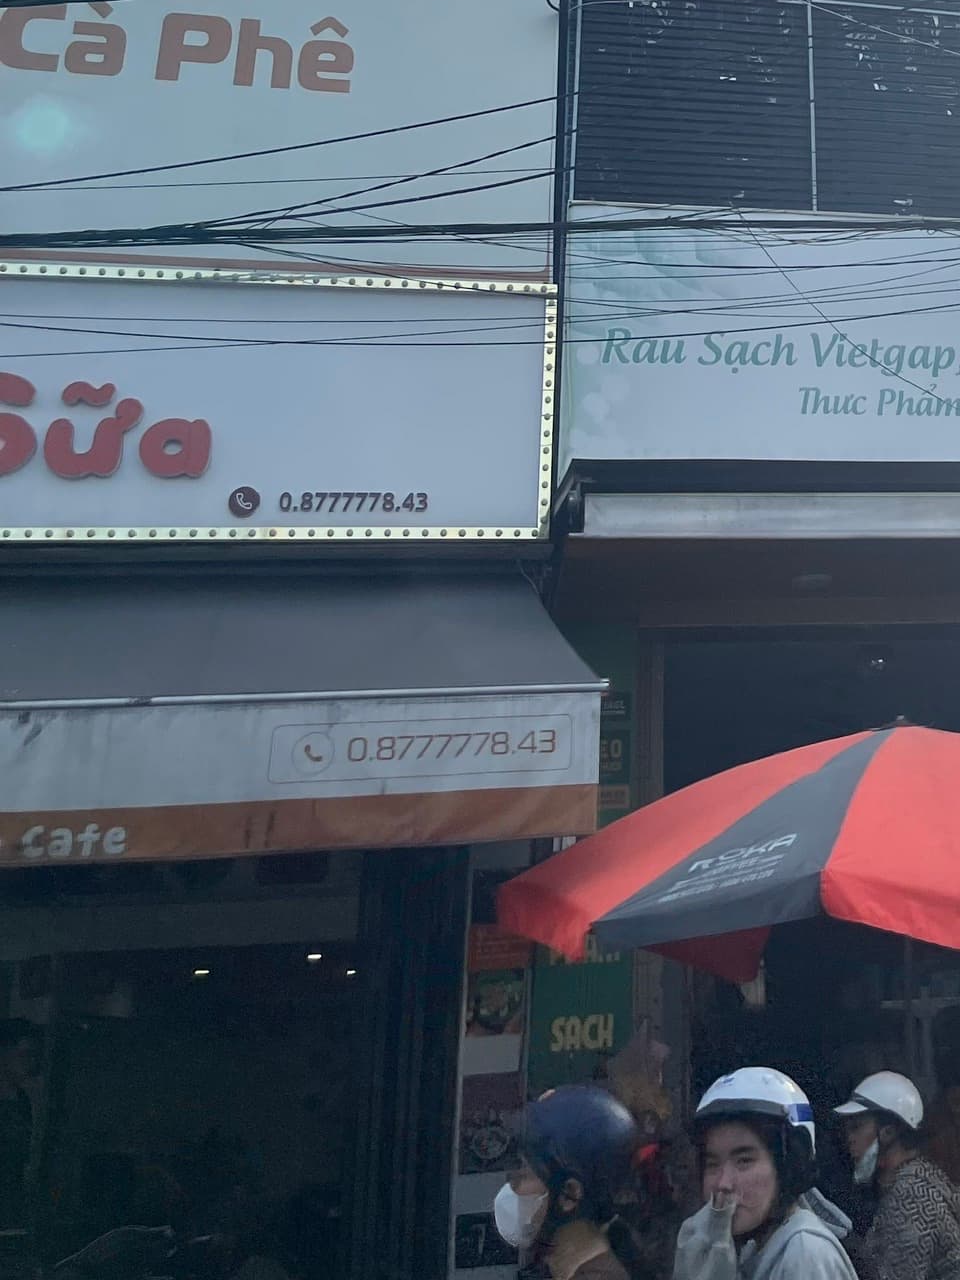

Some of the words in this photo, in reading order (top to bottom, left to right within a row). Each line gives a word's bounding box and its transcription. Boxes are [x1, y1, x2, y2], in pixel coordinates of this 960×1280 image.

[0, 2, 128, 77] Cà
[154, 16, 355, 94] Phê
[602, 327, 687, 365] Rau
[697, 332, 797, 375] Sạch
[279, 491, 429, 514] 0.8777778.43
[347, 729, 557, 762] 0.8777778.43
